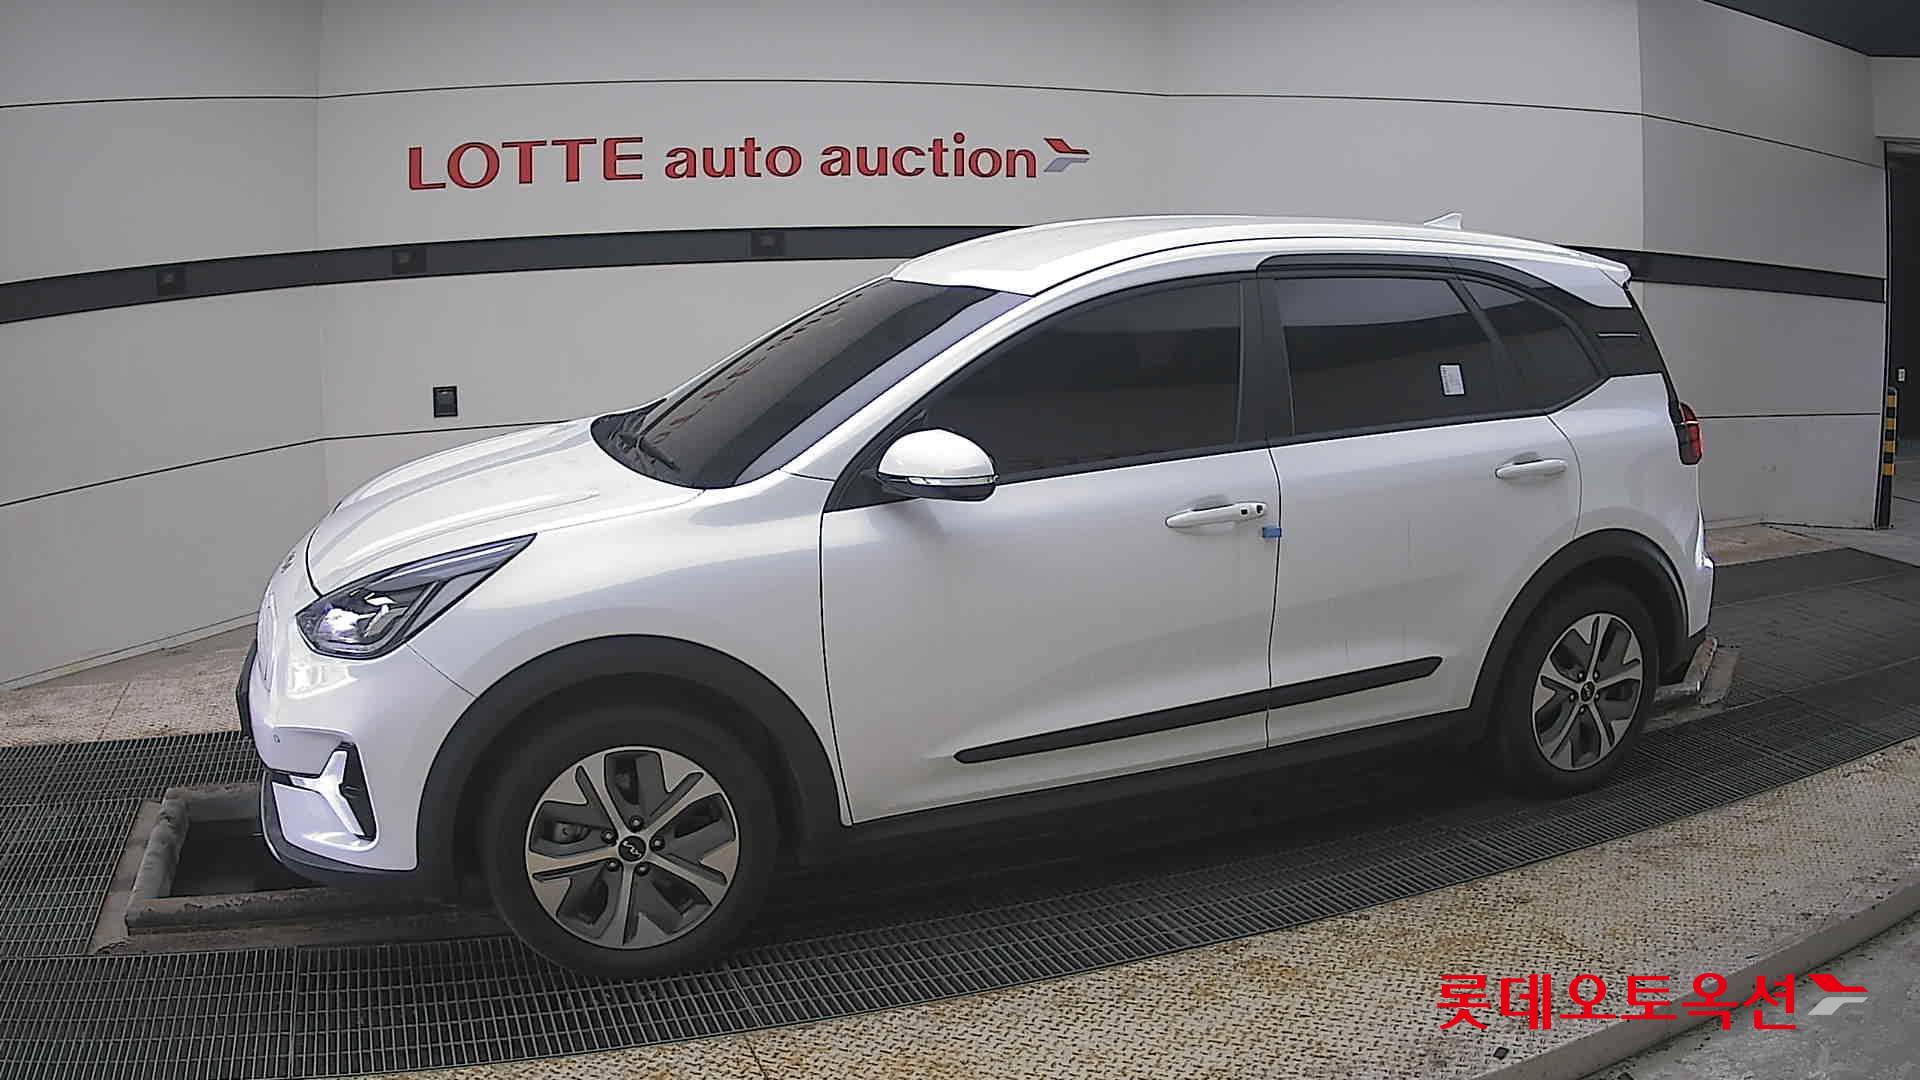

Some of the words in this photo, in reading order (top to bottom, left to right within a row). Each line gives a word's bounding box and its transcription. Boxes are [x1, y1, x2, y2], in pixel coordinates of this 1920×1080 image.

[408, 136, 643, 192] LOTTE
[665, 136, 802, 179] auto
[820, 132, 1037, 178] auction
